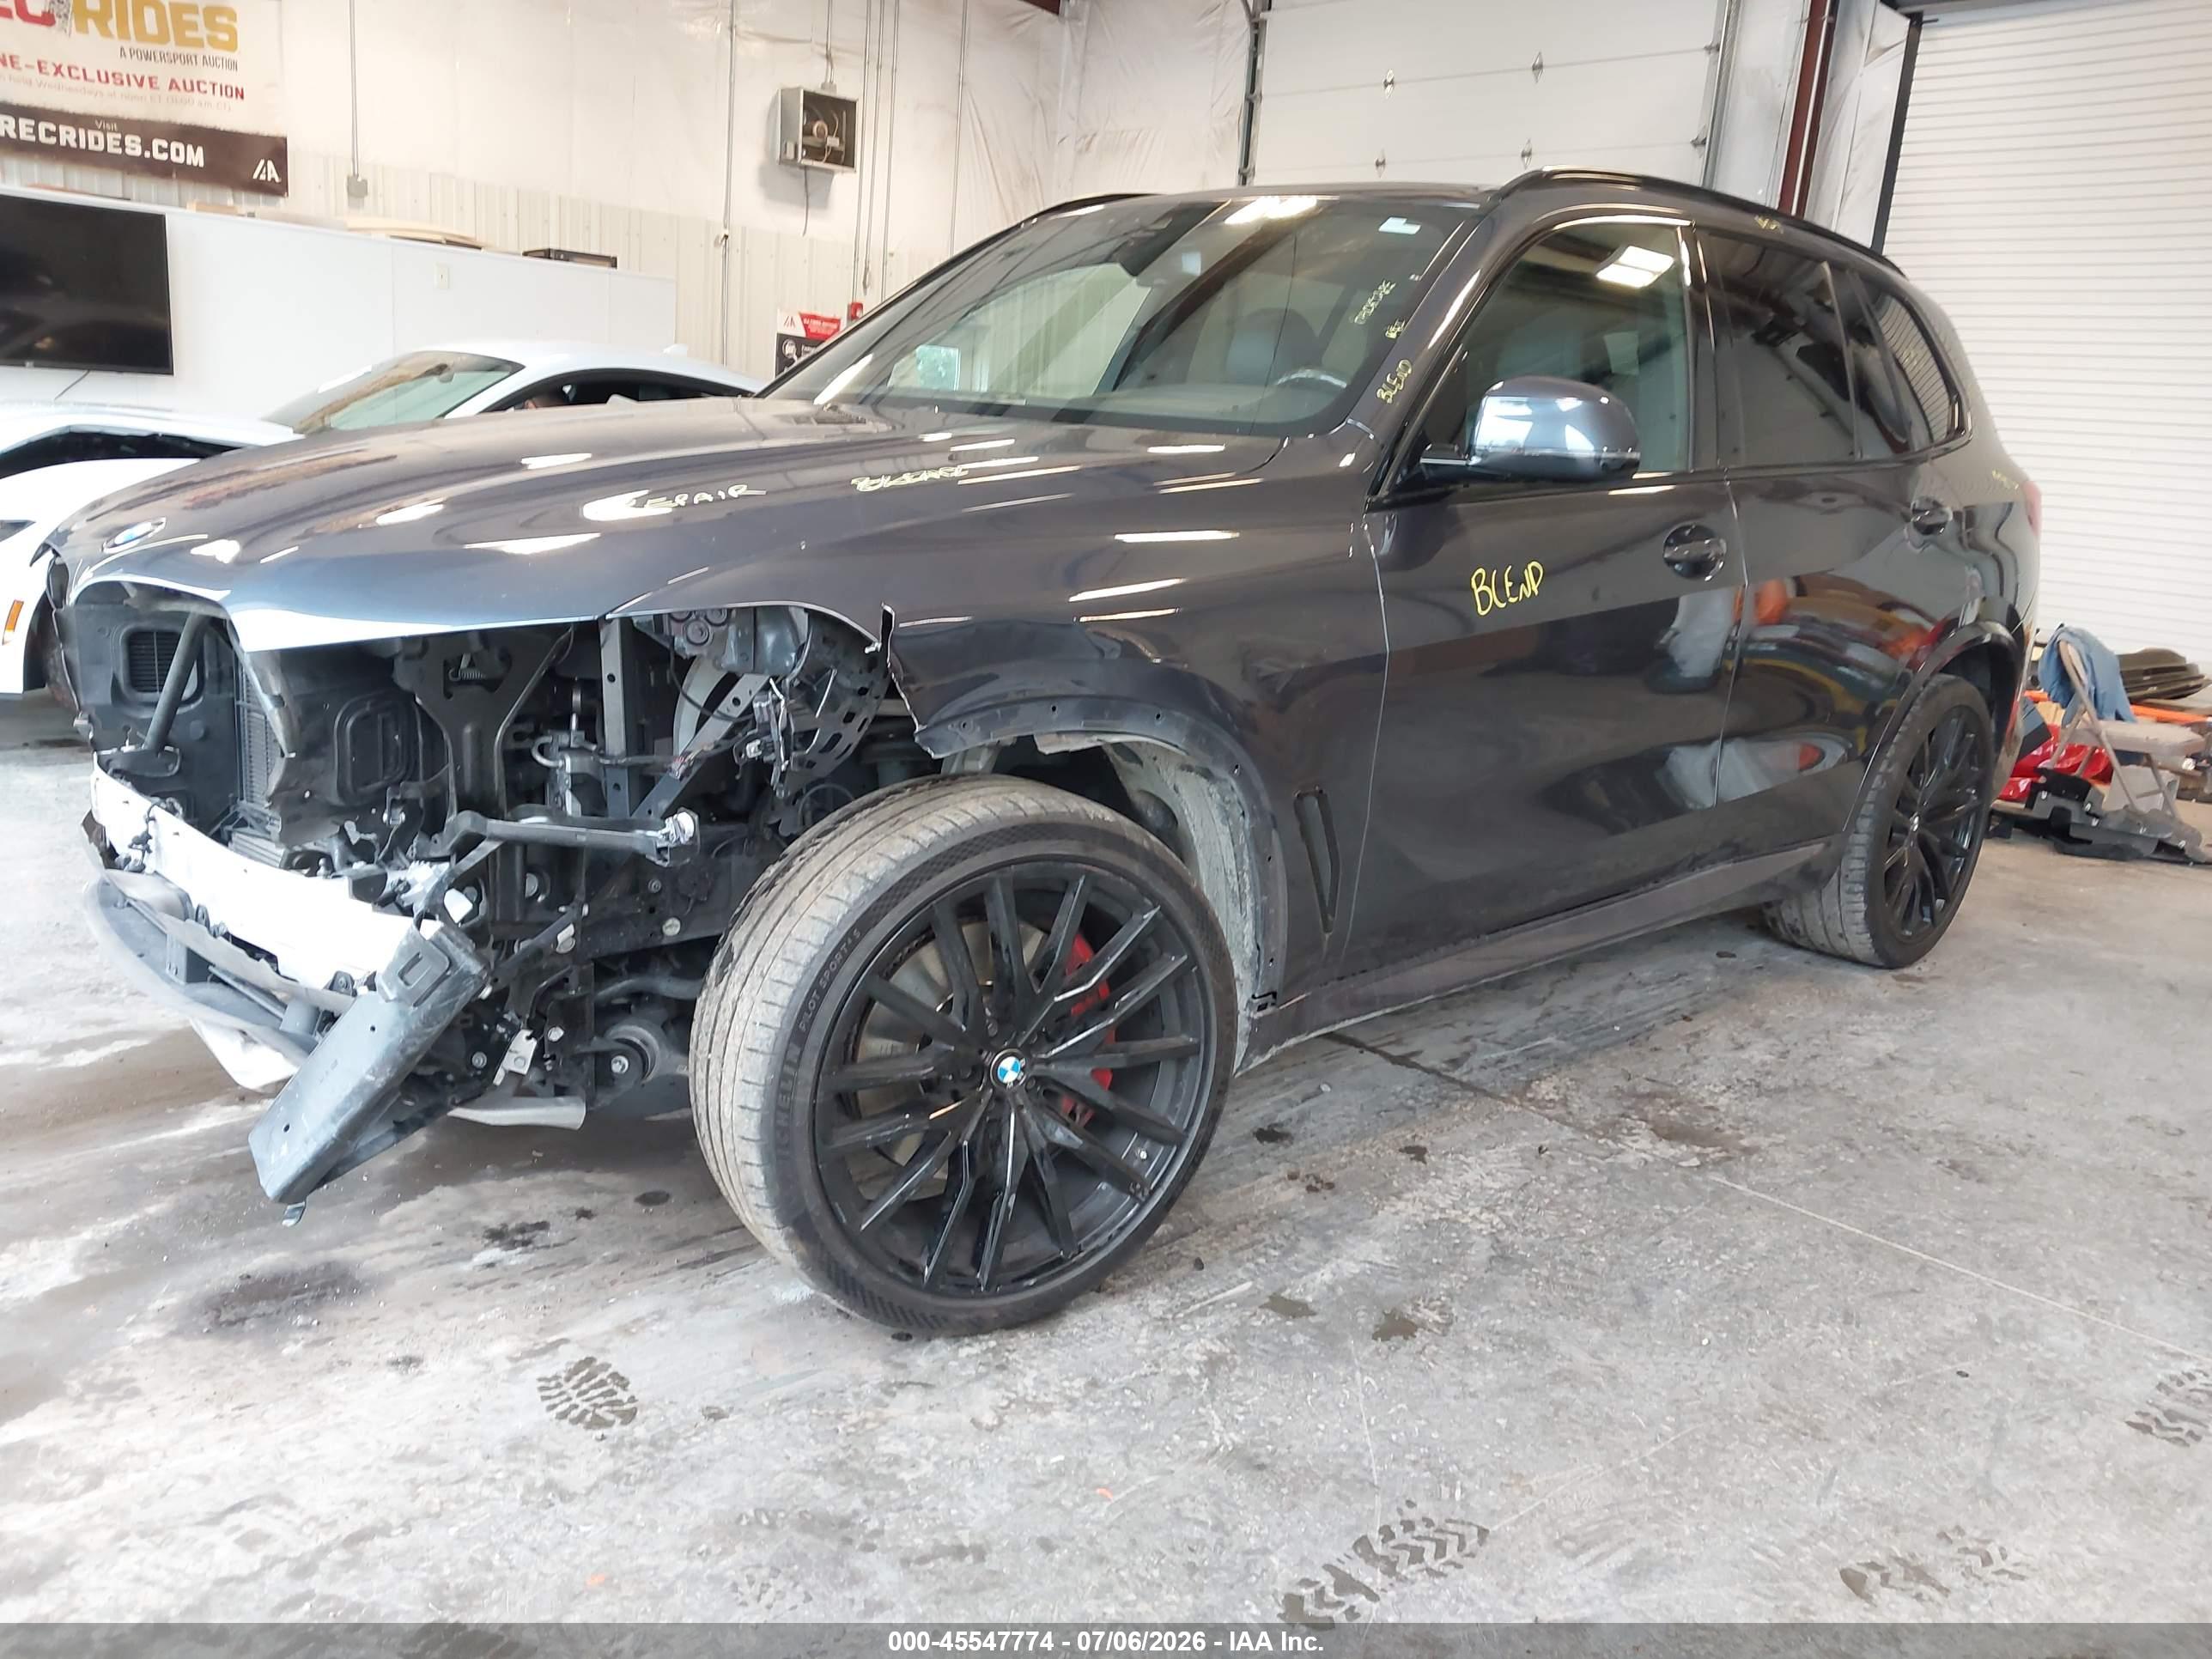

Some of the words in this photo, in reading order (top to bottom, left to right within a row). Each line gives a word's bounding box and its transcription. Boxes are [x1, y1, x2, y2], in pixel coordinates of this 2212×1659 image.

[72, 0, 239, 53] RIDES
[119, 46, 126, 59] A
[129, 47, 198, 67] POWERSPORT
[202, 54, 238, 71] AUCTION
[168, 77, 245, 100] AUCTION
[0, 114, 204, 167] RECRIDES.COM
[625, 484, 767, 509] EPAIR
[1471, 561, 1544, 616] BLEND
[799, 988, 820, 1032] PILOT
[819, 942, 848, 989] SPORT
[853, 927, 860, 939] S
